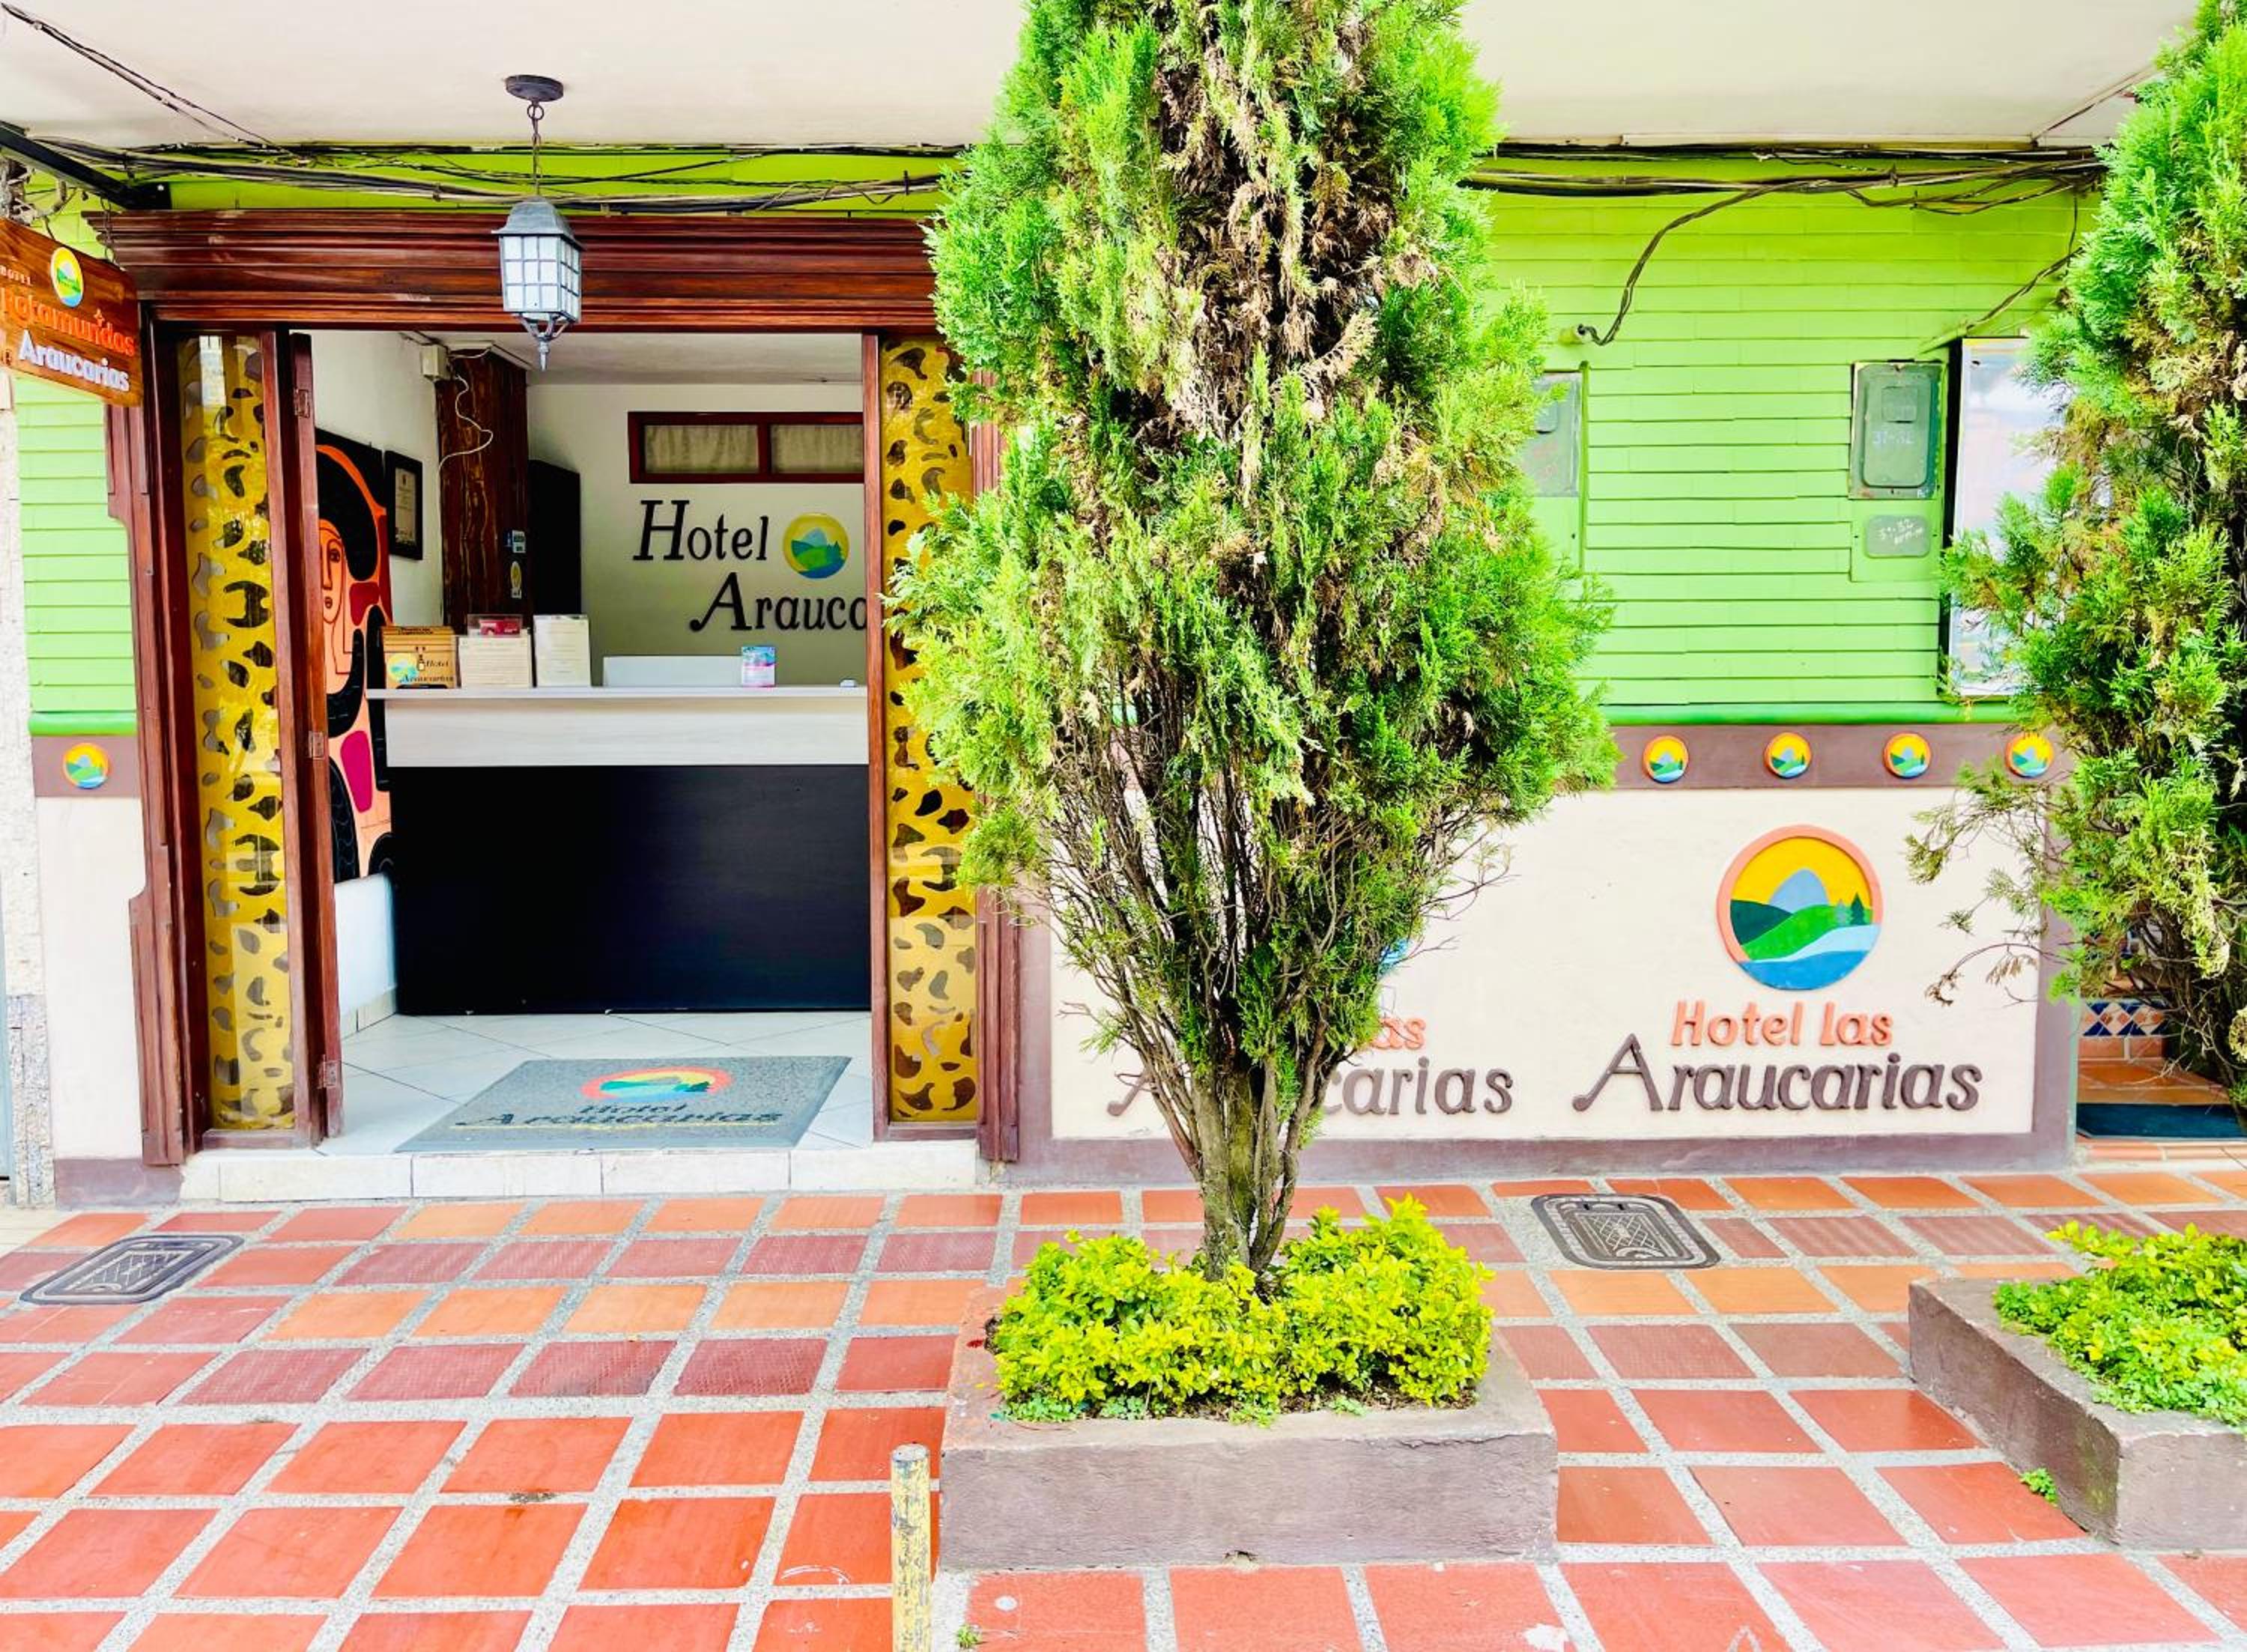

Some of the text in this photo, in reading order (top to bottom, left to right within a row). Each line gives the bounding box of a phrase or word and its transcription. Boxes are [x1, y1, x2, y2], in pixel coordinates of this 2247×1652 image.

[19, 330, 130, 392] Araucarias
[633, 499, 769, 561] Hotel
[689, 572, 867, 631] Arauca
[1363, 1018, 1426, 1050] as
[1671, 1000, 1893, 1046] Hotel las
[1572, 1033, 1983, 1111] Araucarias
[455, 1112, 783, 1126] Araucarias
[578, 1104, 688, 1114] Hotel
